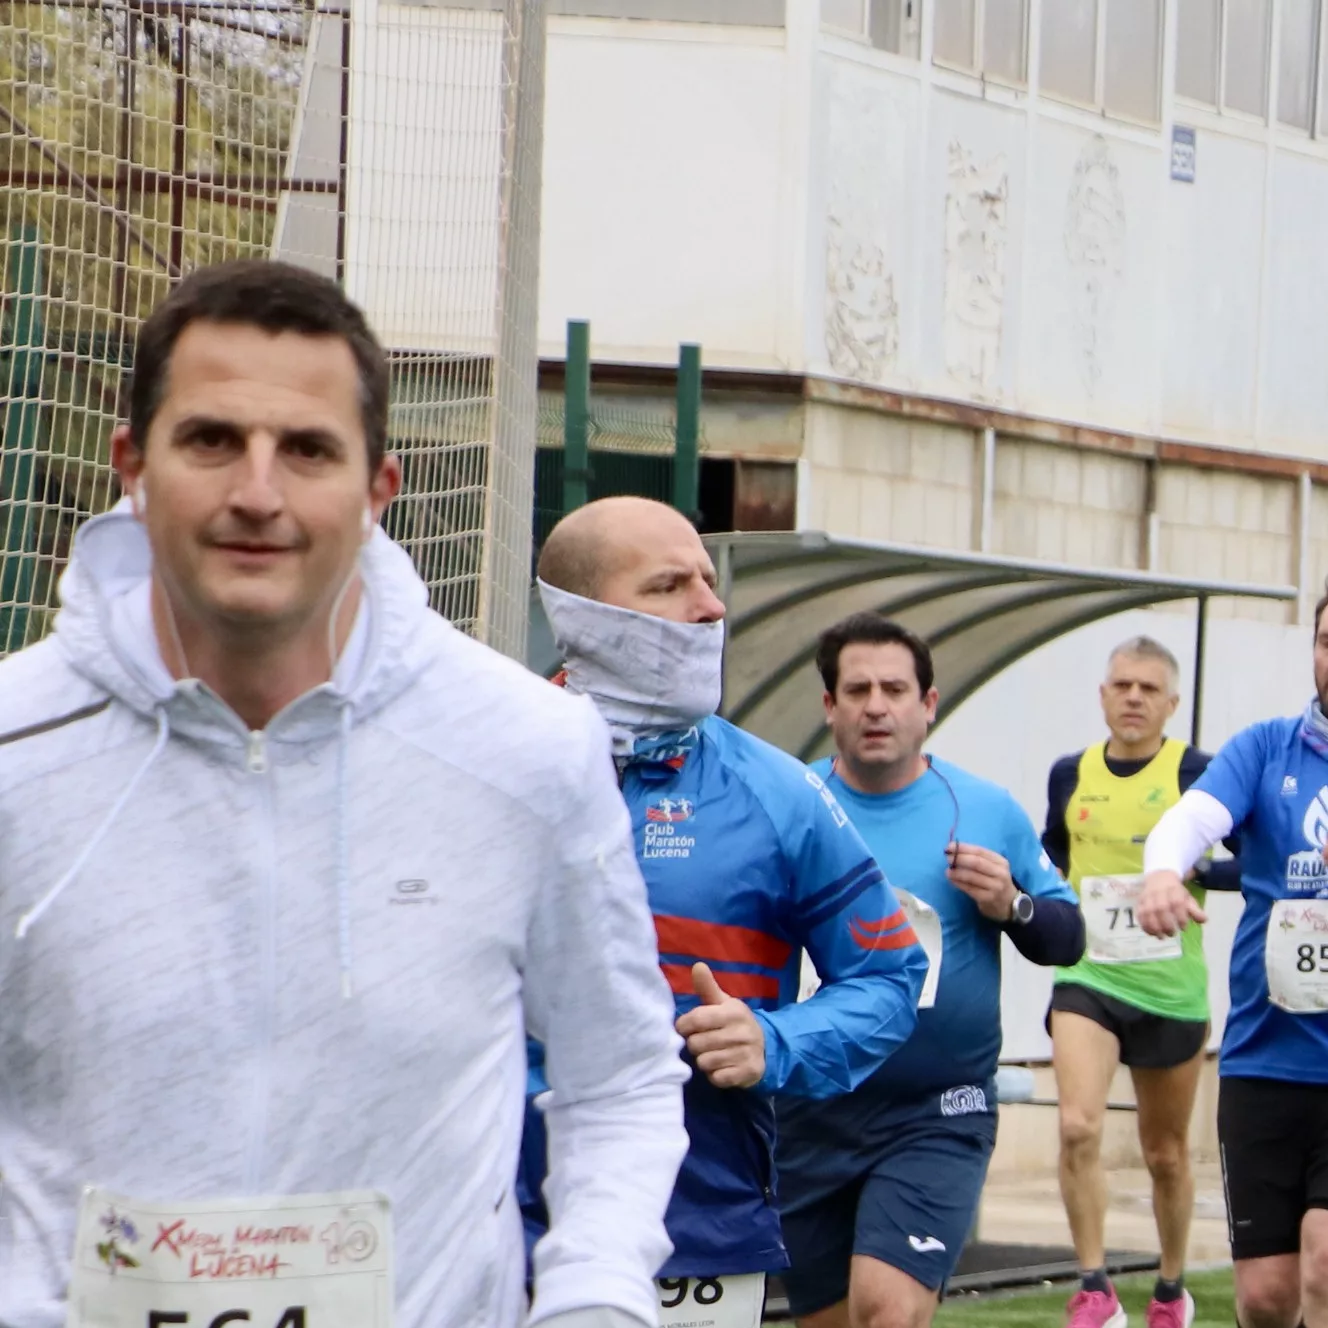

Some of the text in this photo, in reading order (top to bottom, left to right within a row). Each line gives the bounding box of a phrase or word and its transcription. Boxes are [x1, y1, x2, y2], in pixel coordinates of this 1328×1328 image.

[644, 823, 675, 836] Club
[643, 836, 696, 848] Maratón
[643, 847, 691, 859] Lucena
[1105, 907, 1140, 931] 71
[188, 1250, 293, 1279] LUCENA
